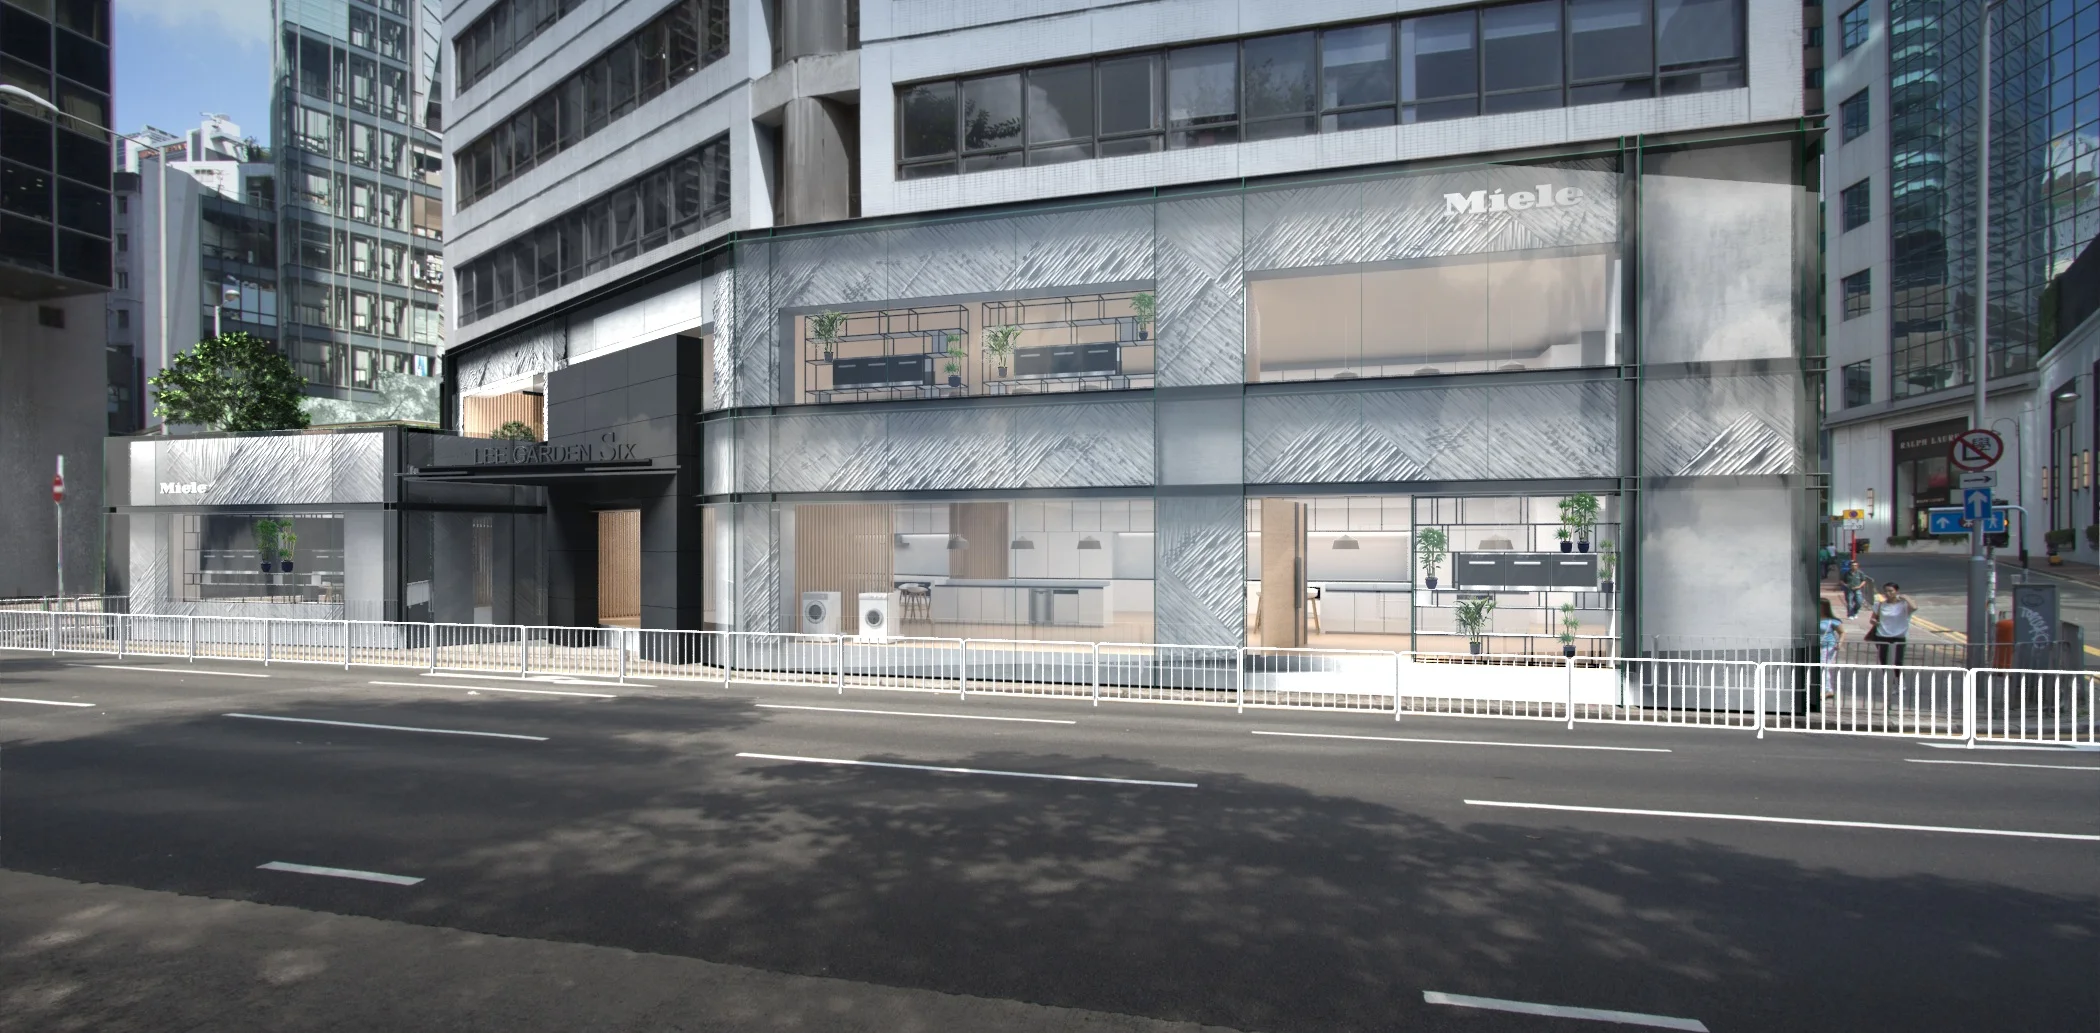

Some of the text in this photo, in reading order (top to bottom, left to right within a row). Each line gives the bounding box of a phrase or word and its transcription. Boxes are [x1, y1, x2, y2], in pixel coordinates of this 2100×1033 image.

[1443, 184, 1584, 216] Miele
[1900, 438, 1928, 449] RALPH
[474, 446, 508, 465] LEE
[513, 444, 592, 464] GARDEN
[160, 481, 208, 494] Miele
